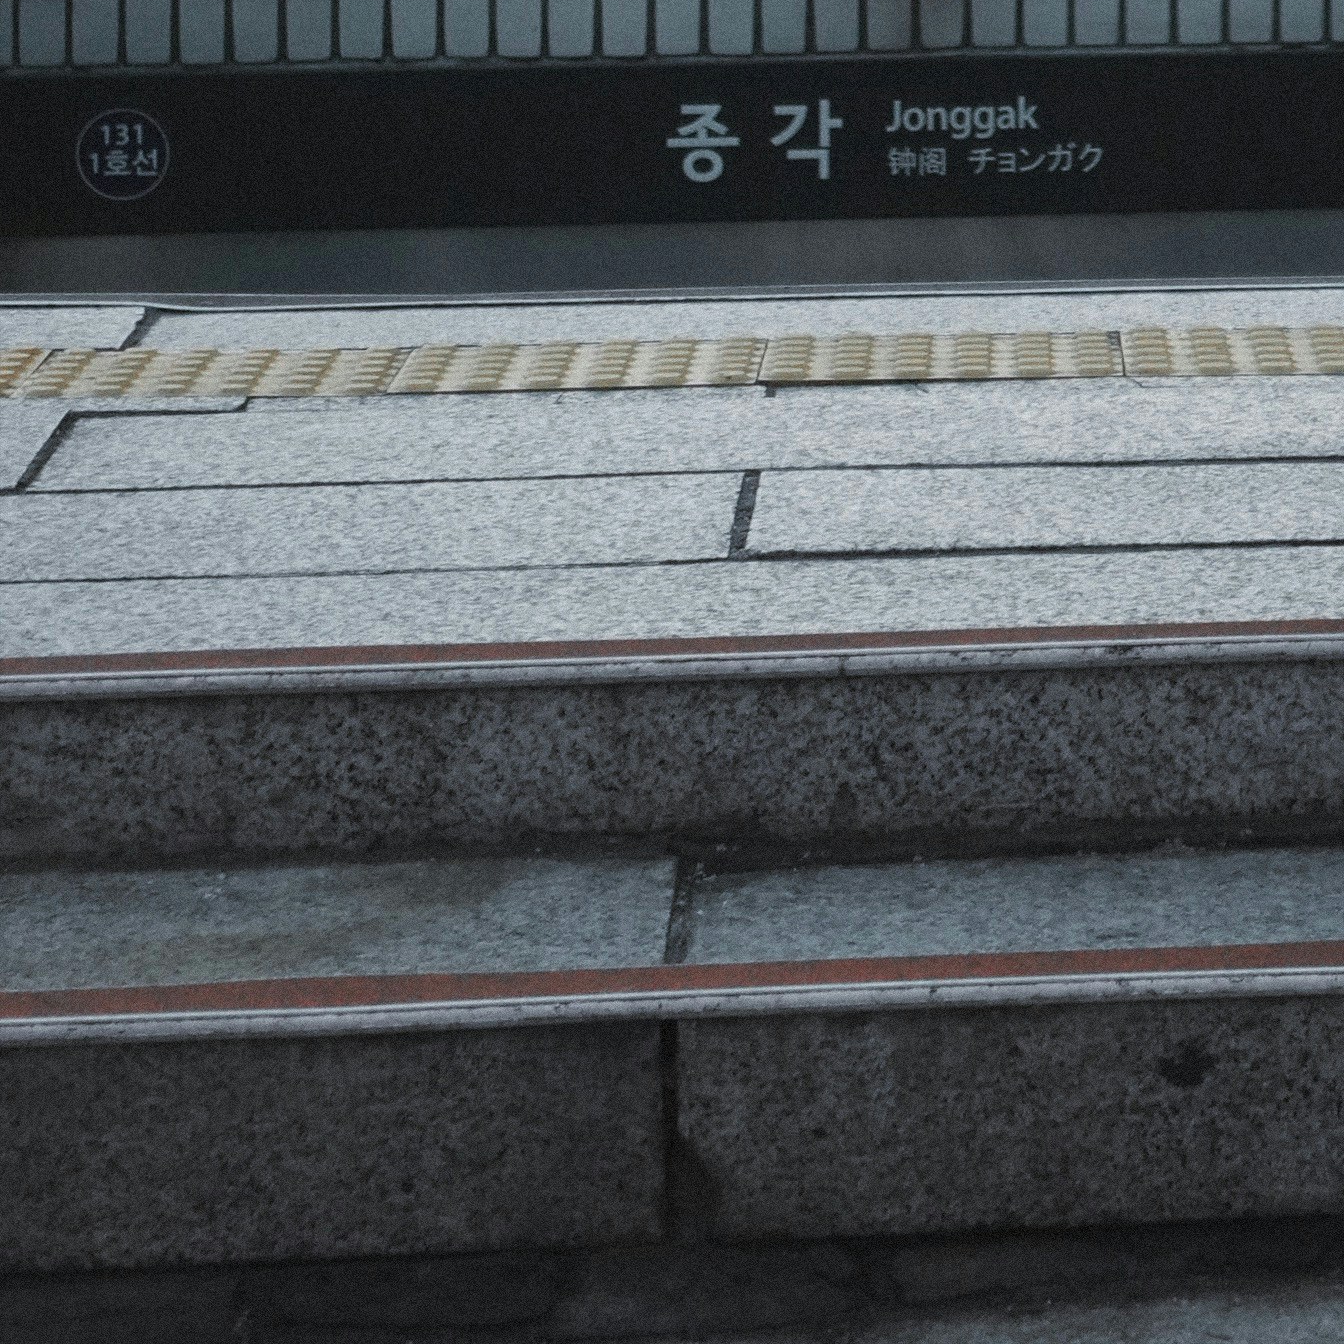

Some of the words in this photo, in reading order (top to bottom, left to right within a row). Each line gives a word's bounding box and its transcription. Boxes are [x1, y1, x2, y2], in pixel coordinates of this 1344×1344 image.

[886, 95, 1039, 140] Jonggak
[101, 123, 143, 145] 131
[90, 148, 158, 176] 1호선
[968, 143, 1103, 175] チョンガク
